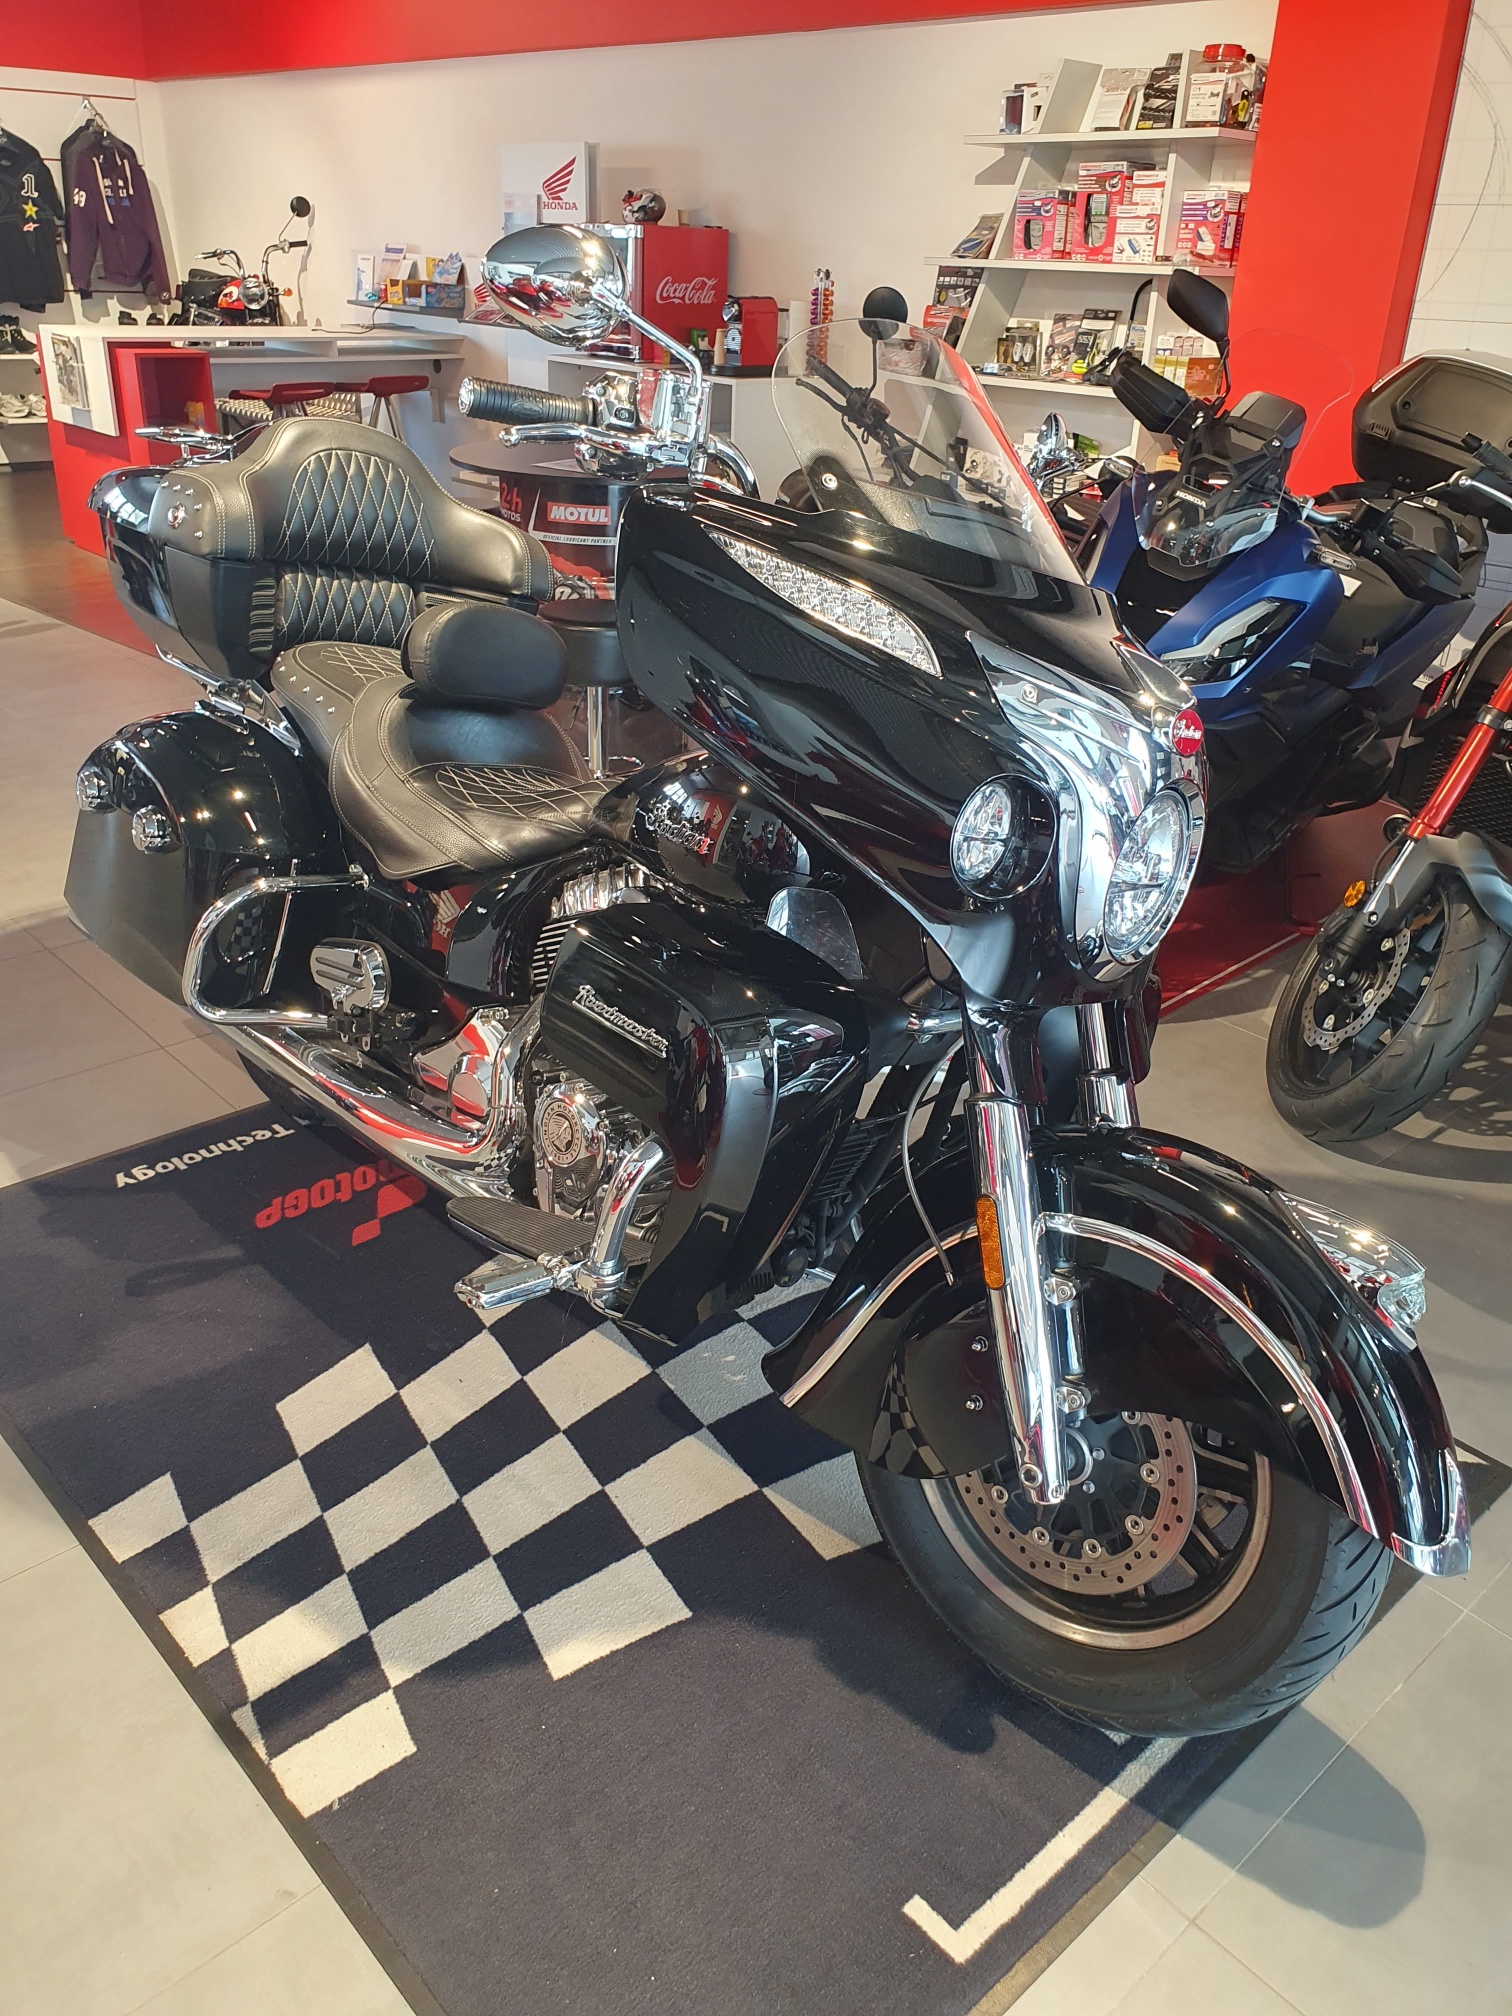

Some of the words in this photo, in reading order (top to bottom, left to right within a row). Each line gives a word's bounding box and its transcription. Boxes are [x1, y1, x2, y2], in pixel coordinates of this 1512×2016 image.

[542, 201, 579, 211] HONDA
[655, 276, 720, 304] Coca-Cola
[1175, 490, 1207, 508] HONDA
[550, 505, 609, 523] MOTUL
[542, 534, 562, 542] OFFICIAL
[563, 536, 590, 544] LUBRICANT
[590, 537, 613, 545] PARTNER
[636, 800, 714, 855] Indian
[572, 984, 669, 1057] Roadmaster
[543, 1107, 556, 1141] INDIAN
[557, 1104, 580, 1158] MOTORCYCLE
[115, 1122, 295, 1188] Technology
